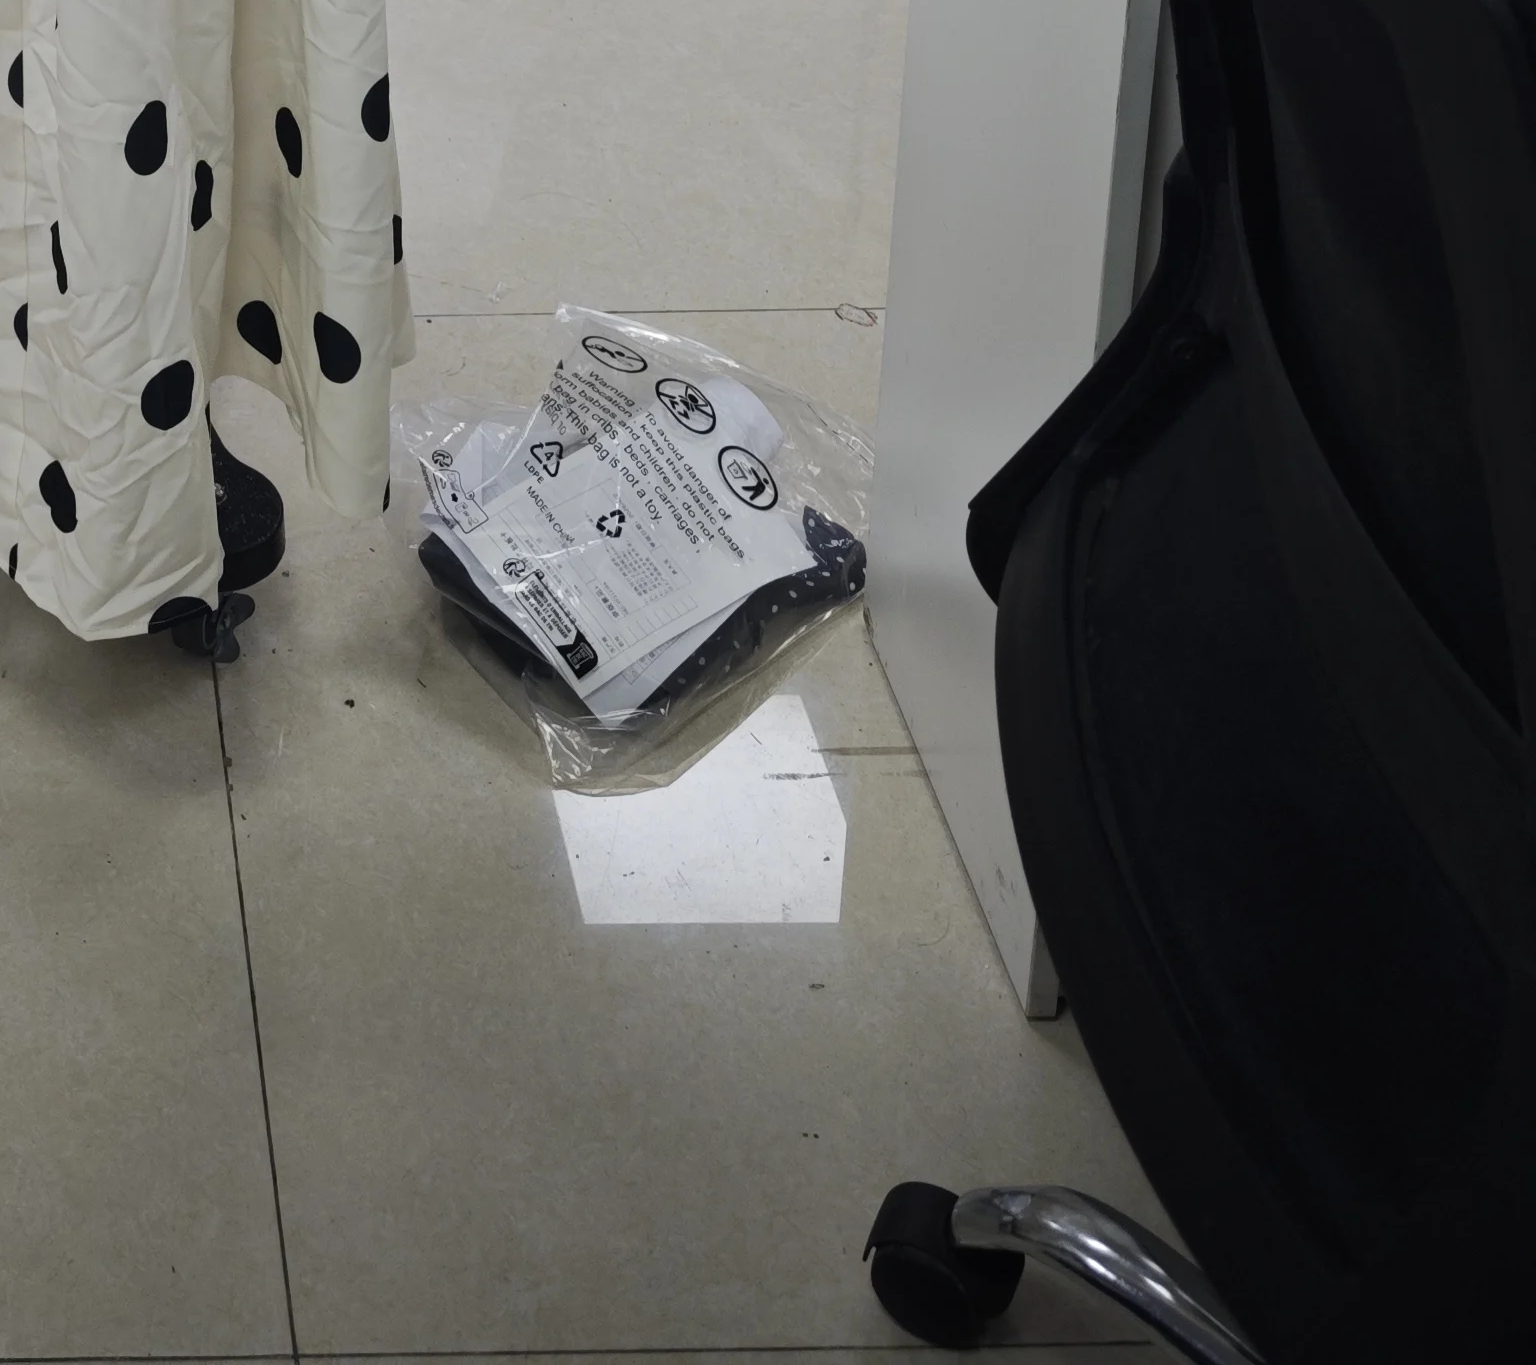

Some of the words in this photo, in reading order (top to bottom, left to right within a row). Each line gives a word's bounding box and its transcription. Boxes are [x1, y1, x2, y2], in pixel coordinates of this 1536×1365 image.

[554, 384, 577, 405] bag
[577, 402, 591, 414] in
[524, 460, 545, 484] LDPE
[544, 451, 555, 461] 4
[565, 408, 589, 435] This
[587, 432, 610, 461] bag
[609, 453, 621, 469] is
[619, 466, 640, 488] not
[636, 488, 646, 499] a
[645, 499, 663, 524] toy.
[578, 390, 618, 420] babies
[618, 419, 641, 442] and
[682, 501, 696, 519] do
[696, 520, 715, 542] not
[640, 423, 665, 456] keep
[665, 457, 684, 481] this
[683, 482, 718, 525] plastic
[717, 526, 745, 559] bags
[645, 411, 657, 427] To
[657, 428, 685, 462] avoid
[683, 462, 719, 506] danger
[718, 507, 733, 521] of
[526, 486, 549, 513] MADE
[545, 512, 555, 523] IN
